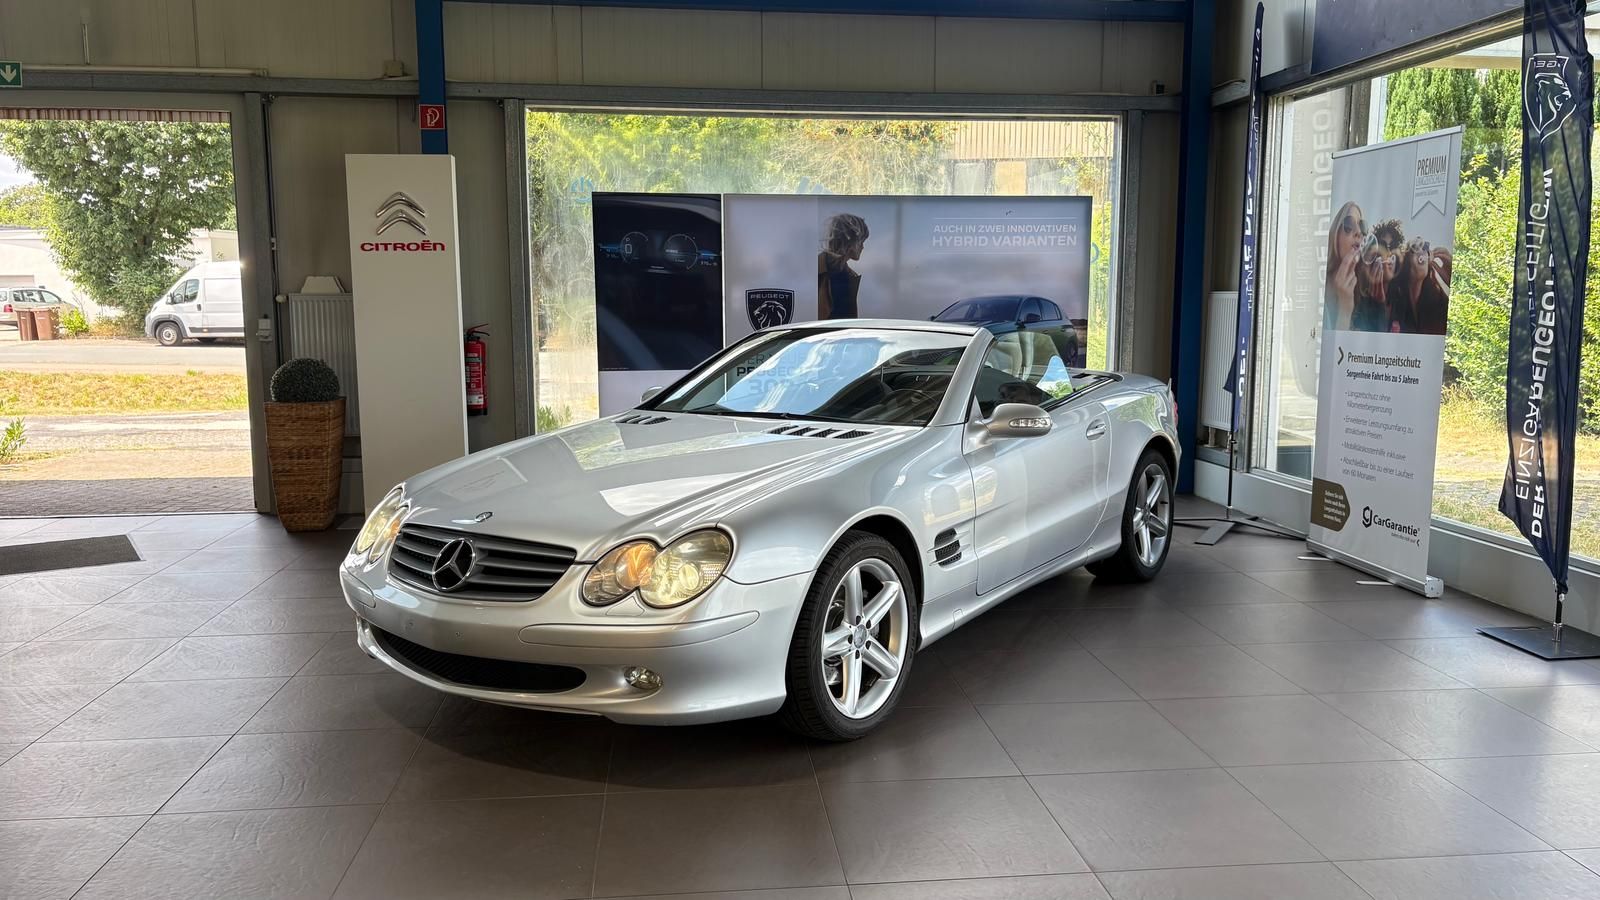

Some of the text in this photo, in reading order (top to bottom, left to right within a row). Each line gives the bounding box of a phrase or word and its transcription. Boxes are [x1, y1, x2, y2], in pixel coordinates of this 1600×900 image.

[1416, 155, 1447, 176] PREMIUM
[933, 224, 1077, 233] AUCH IN ZWEI INNOVATIVEN
[932, 235, 1077, 247] HYBRID VARIANTEN
[1347, 352, 1421, 368] Premium Langzeitschutz
[1346, 369, 1371, 380] Sorgenfreie
[1372, 371, 1384, 381] Fahrt
[1398, 374, 1402, 383] 5
[1402, 375, 1419, 384] Jahren
[1373, 514, 1418, 537] CarGarantie
